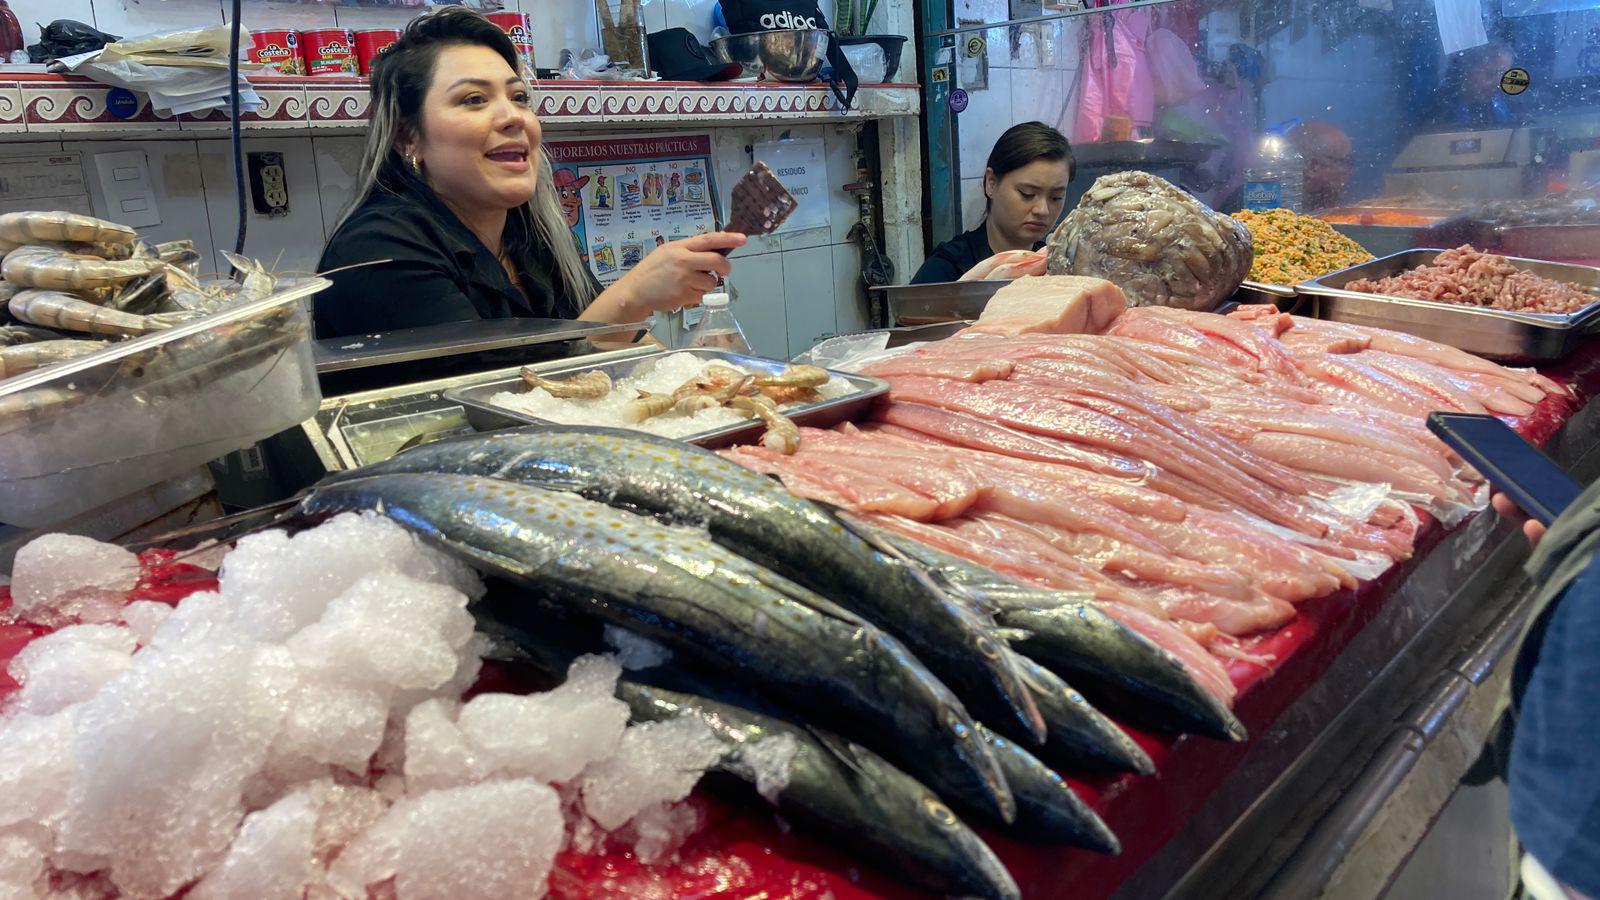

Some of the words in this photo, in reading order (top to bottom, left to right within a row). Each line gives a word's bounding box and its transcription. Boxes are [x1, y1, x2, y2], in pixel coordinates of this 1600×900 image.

[608, 142, 655, 156] NUESTRAS
[655, 140, 698, 153] PRÁCTICAS
[626, 165, 636, 174] NO
[777, 166, 806, 176] RESIDUOS
[595, 235, 605, 243] NO
[651, 229, 660, 237] NO
[696, 223, 705, 231] NO
